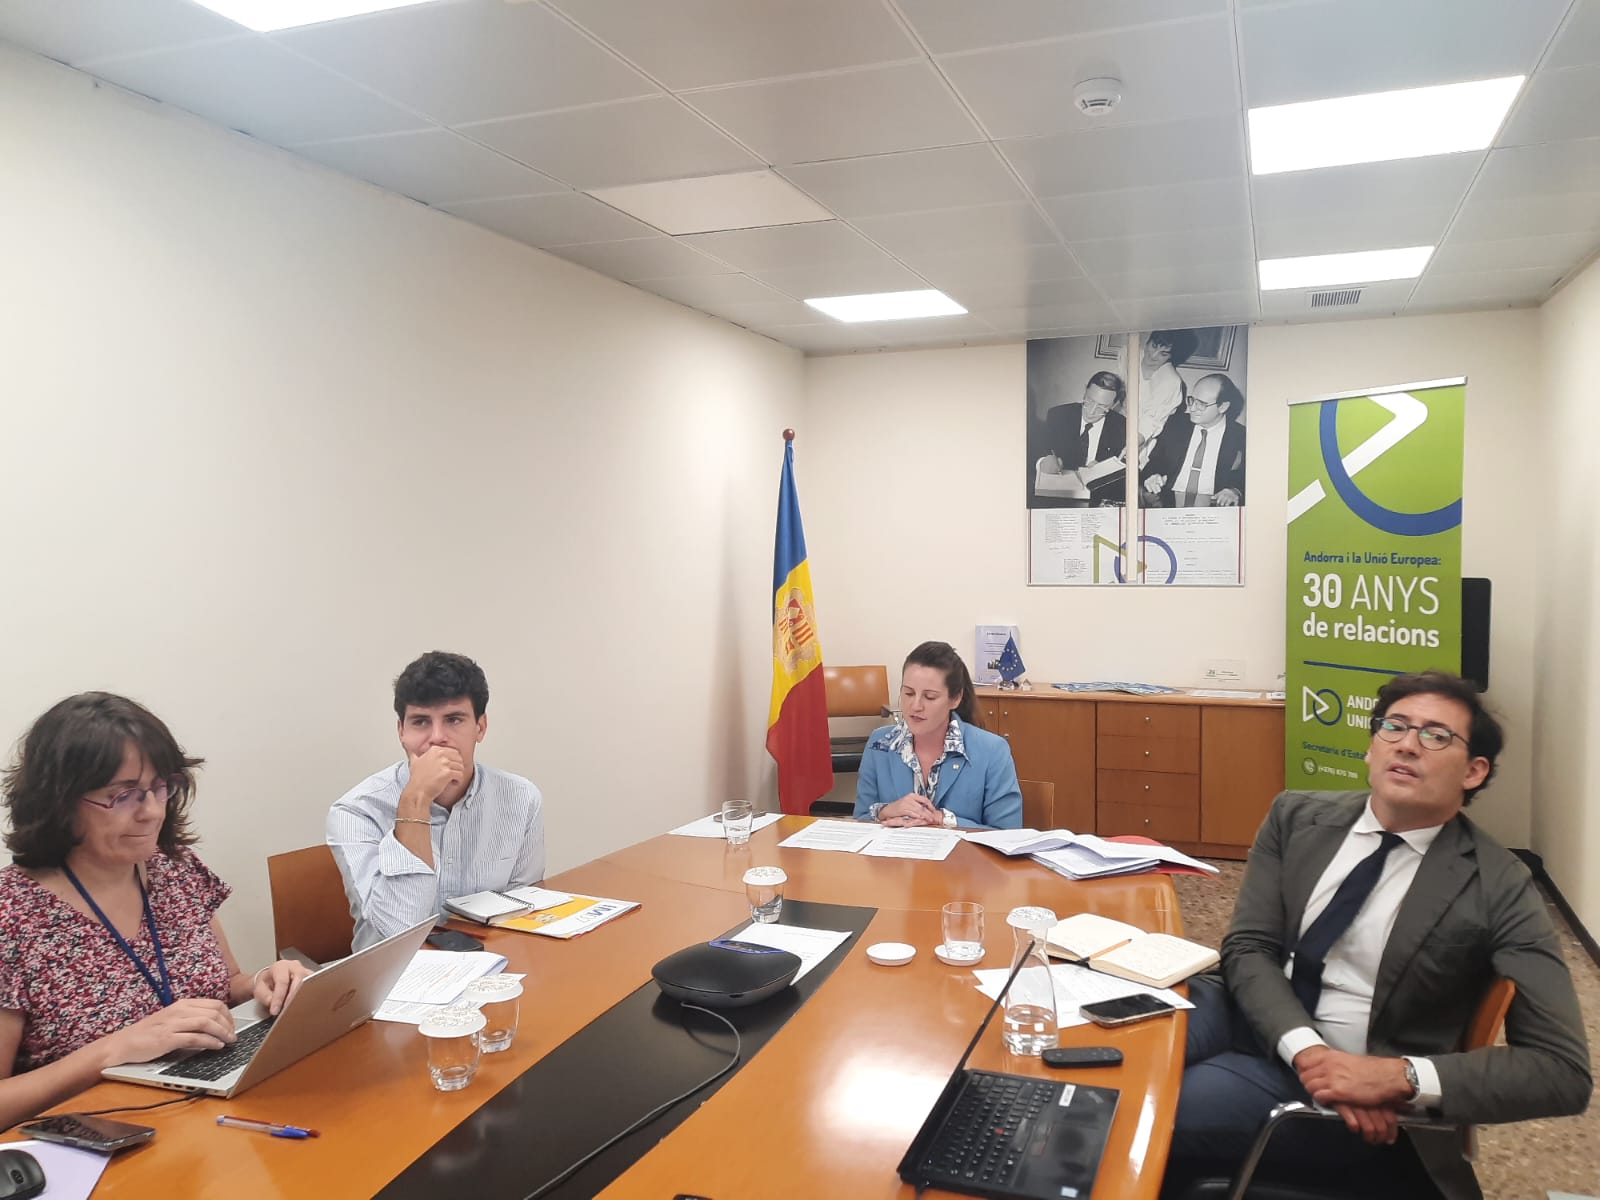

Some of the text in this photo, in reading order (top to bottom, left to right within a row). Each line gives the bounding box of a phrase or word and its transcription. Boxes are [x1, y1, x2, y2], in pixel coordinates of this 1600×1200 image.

[1304, 551, 1442, 567] Andorra i la Unió Europea:
[1303, 572, 1439, 615] 30 ANYS
[1303, 612, 1440, 648] de relacions
